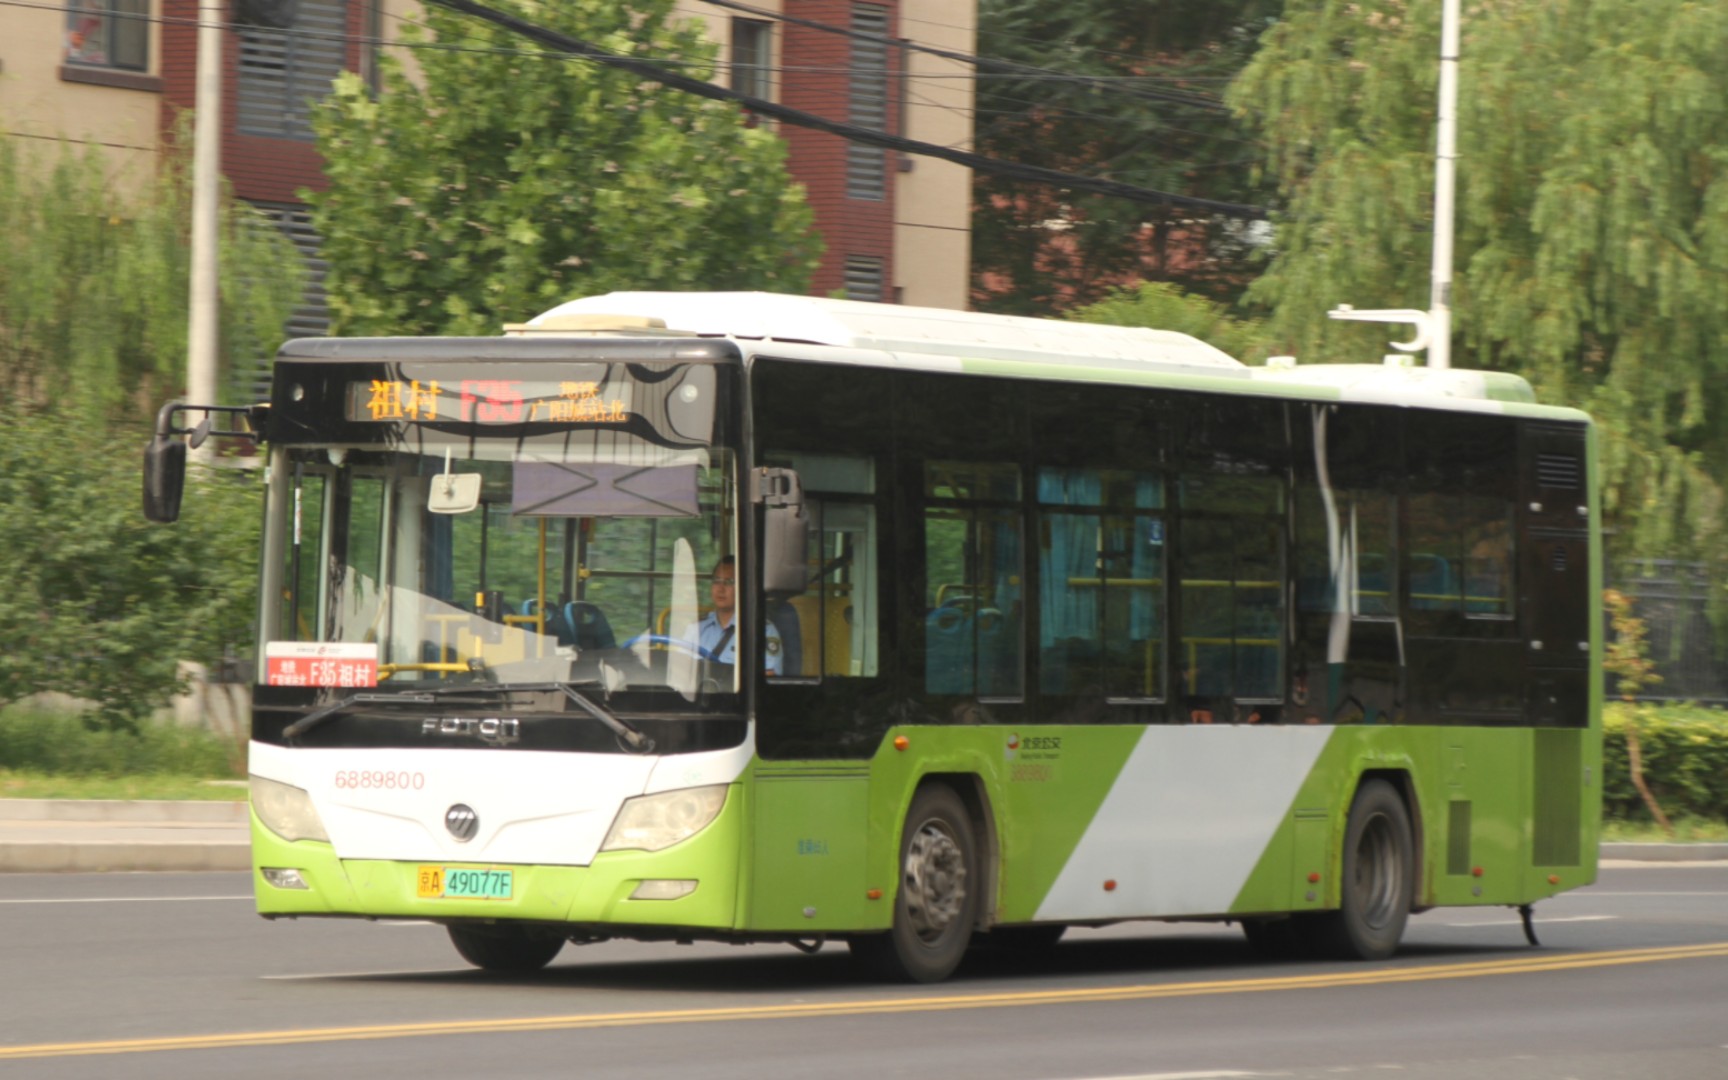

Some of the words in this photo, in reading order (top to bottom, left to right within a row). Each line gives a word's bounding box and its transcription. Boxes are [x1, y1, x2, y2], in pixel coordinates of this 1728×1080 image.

[367, 379, 442, 420] 祖村
[460, 380, 523, 421] F35
[310, 660, 336, 686] F35
[421, 717, 520, 738] FOTON
[335, 770, 425, 790] 6889800
[448, 872, 511, 894] 49077F
